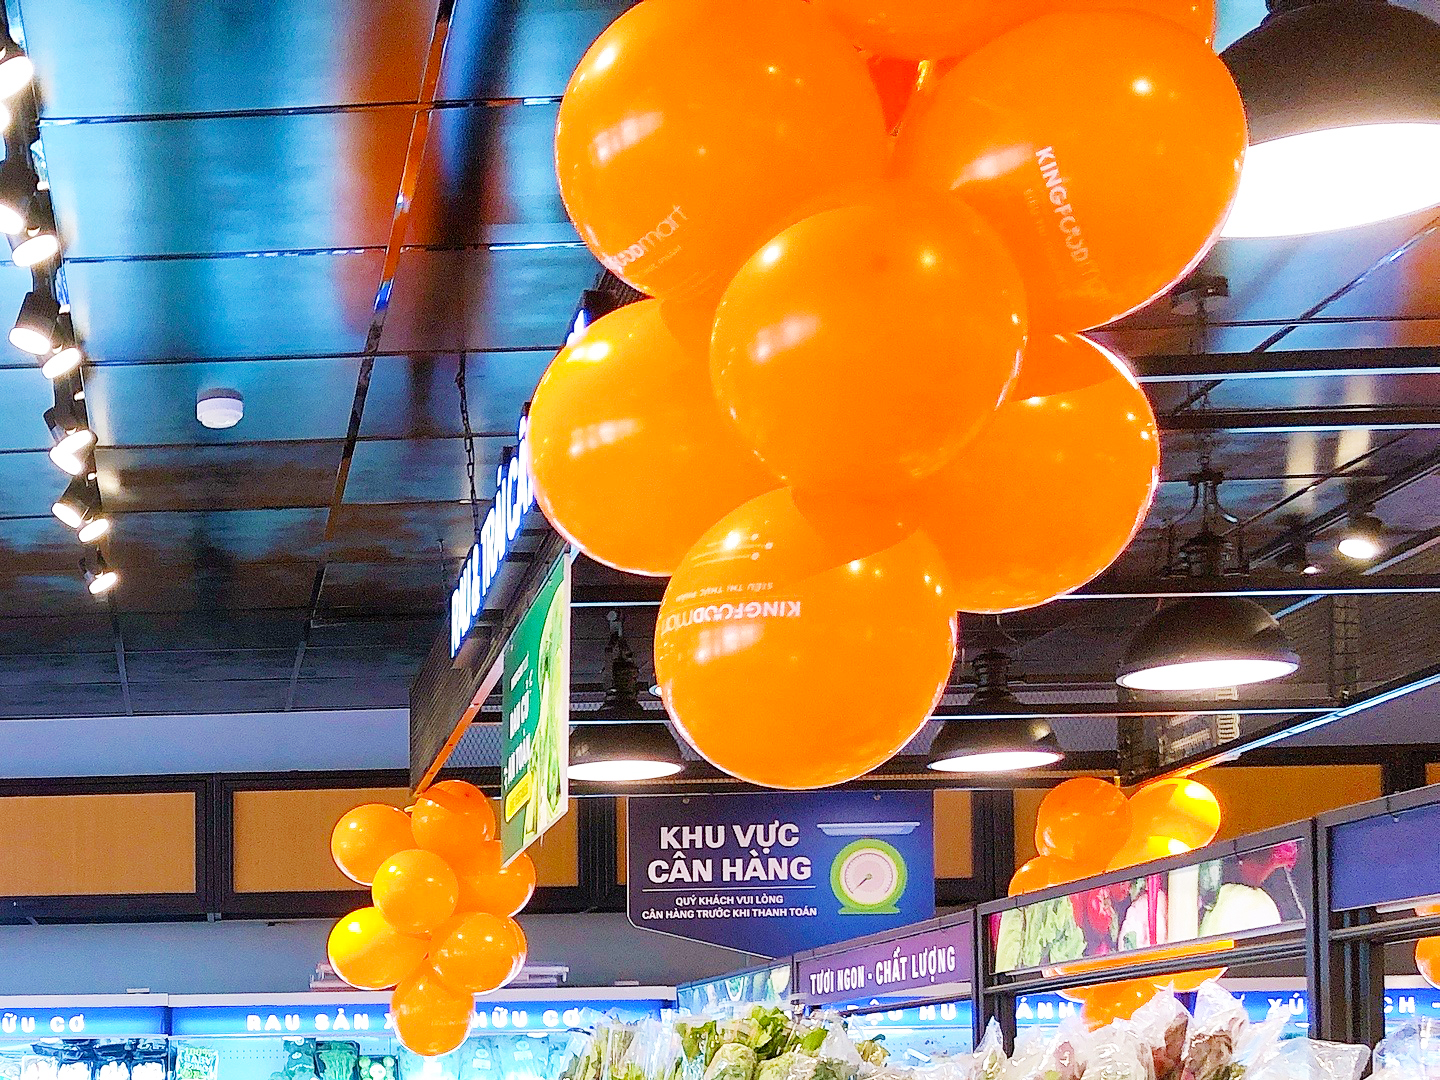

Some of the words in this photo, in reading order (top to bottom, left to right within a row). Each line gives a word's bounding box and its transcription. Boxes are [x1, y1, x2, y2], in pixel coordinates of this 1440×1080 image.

[660, 825, 725, 850] KHU
[732, 820, 800, 854] VỰC
[647, 852, 715, 884] CÂN
[722, 849, 811, 882] HÀNG
[675, 894, 698, 906] QUÝ
[698, 893, 735, 906] KHÁCH
[736, 895, 754, 905] VUI
[755, 893, 784, 905] LÒNG
[641, 908, 664, 920] CÂN
[665, 906, 695, 919] HÀNG
[732, 908, 750, 918] KHI
[751, 907, 788, 918] THANH
[789, 905, 818, 917] TOÁN
[810, 971, 834, 996] TƯƠI
[837, 965, 865, 992] NGON
[875, 947, 908, 985] CHẤT
[911, 946, 956, 983] LƯỢNG
[50, 1012, 85, 1034] CƠ
[246, 1013, 300, 1032] RAU
[314, 1008, 370, 1031] SẢN
[543, 1007, 581, 1028] CƠ
